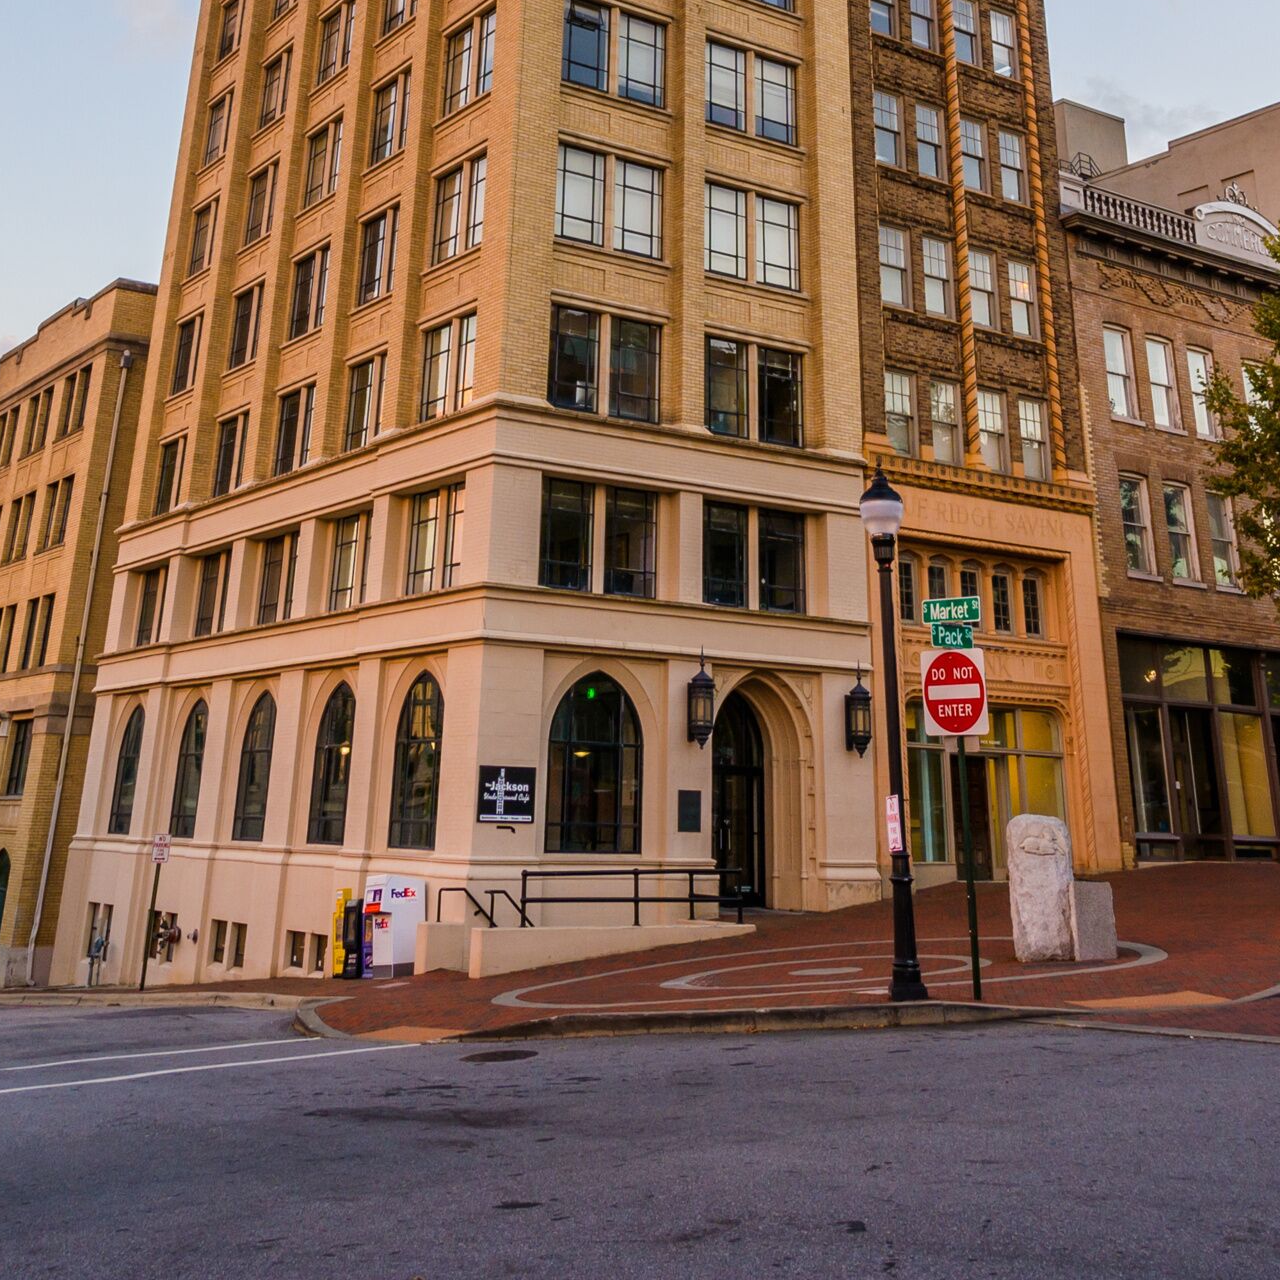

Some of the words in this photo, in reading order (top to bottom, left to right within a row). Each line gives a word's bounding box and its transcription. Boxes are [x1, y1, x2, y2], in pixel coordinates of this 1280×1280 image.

[930, 601, 969, 620] Market
[938, 626, 964, 646] Pack
[931, 668, 946, 681] DO
[953, 666, 973, 680] NOT
[938, 703, 973, 718] ENTER
[391, 888, 416, 898] FedEx
[375, 918, 388, 929] FedEx
